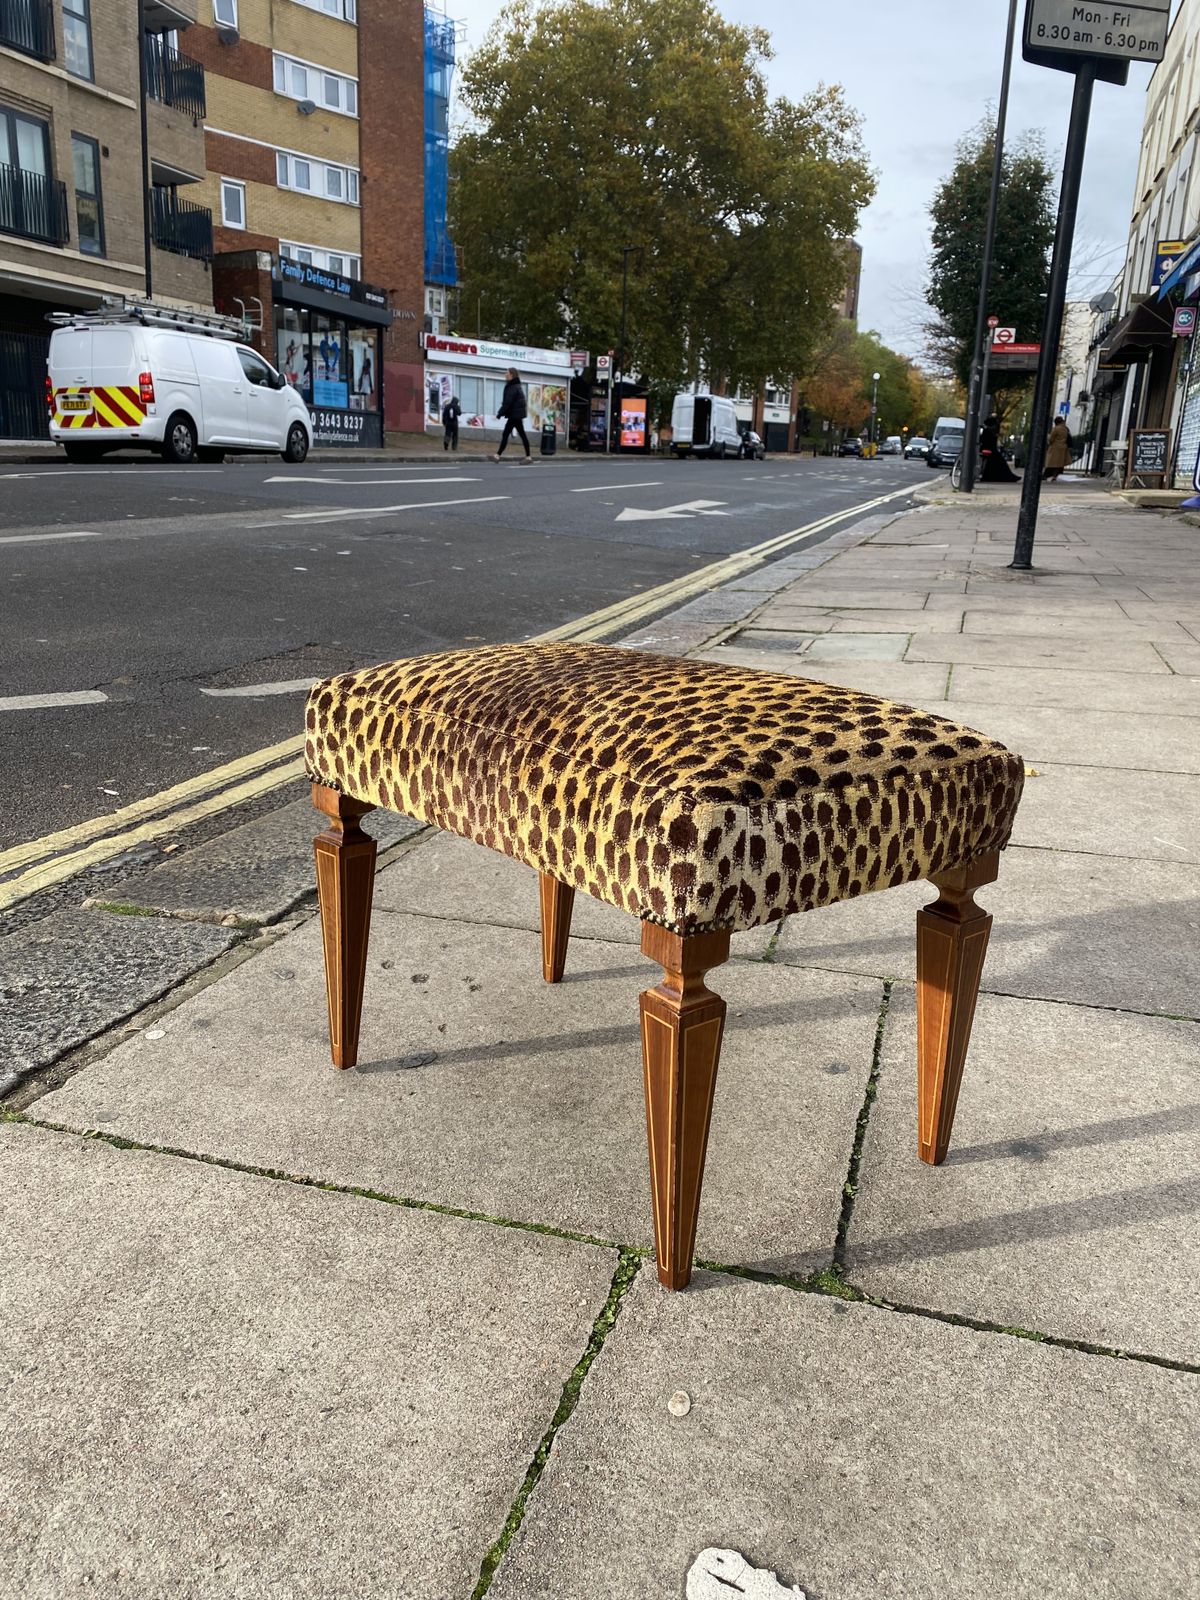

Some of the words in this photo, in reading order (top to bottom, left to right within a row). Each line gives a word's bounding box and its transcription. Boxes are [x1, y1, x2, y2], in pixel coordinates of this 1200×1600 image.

[1072, 7, 1100, 23] Mon
[1113, 12, 1131, 27] Fri
[1037, 23, 1070, 40] 8.30
[1073, 30, 1093, 43] am
[1104, 32, 1136, 48] 6.30
[1139, 39, 1159, 52] pm
[280, 260, 305, 282] Family
[306, 268, 335, 289] Defence
[337, 278, 351, 294] Law
[426, 335, 477, 354] Marmara
[480, 344, 526, 359] Supermarket
[320, 412, 340, 428] 3643
[344, 415, 363, 429] 8237
